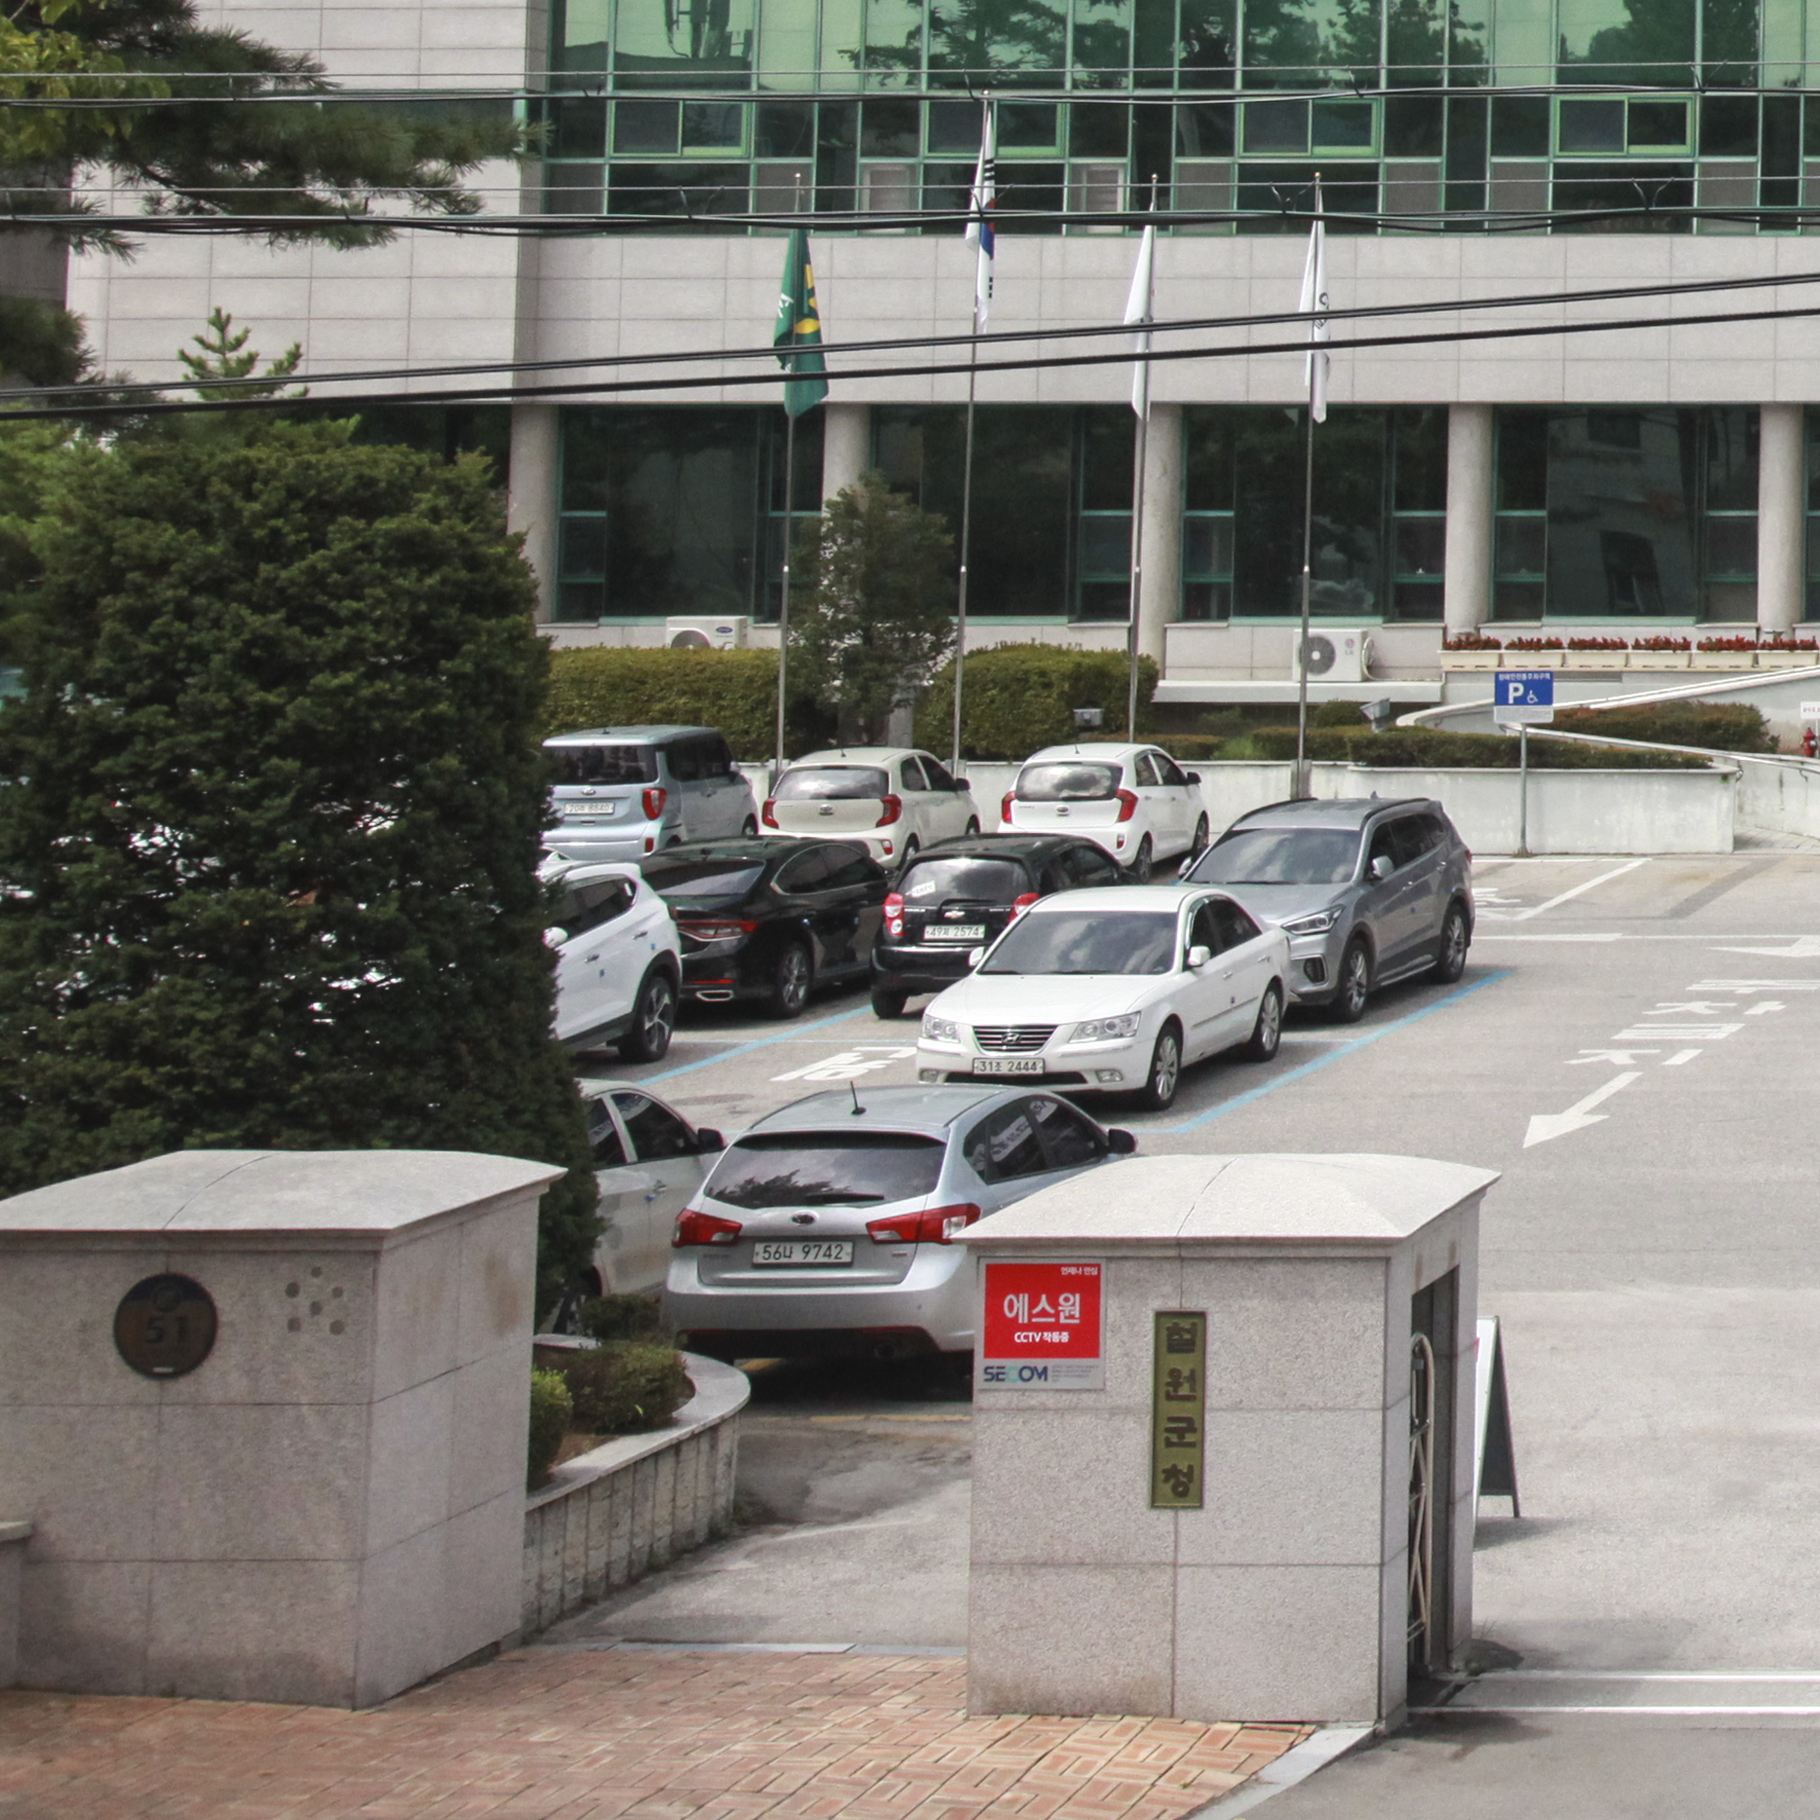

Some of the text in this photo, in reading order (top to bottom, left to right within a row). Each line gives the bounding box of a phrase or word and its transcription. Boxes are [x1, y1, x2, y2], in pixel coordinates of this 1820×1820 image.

[1508, 682, 1525, 704] P
[953, 926, 979, 937] 2574
[1007, 1060, 1038, 1072] 2444
[802, 1243, 843, 1261] 9742
[1003, 1292, 1081, 1324] 에스원
[1013, 1331, 1070, 1343] CCTV 작동중
[983, 1365, 1049, 1383] SECOM
[1161, 1320, 1198, 1499] 철원군청
